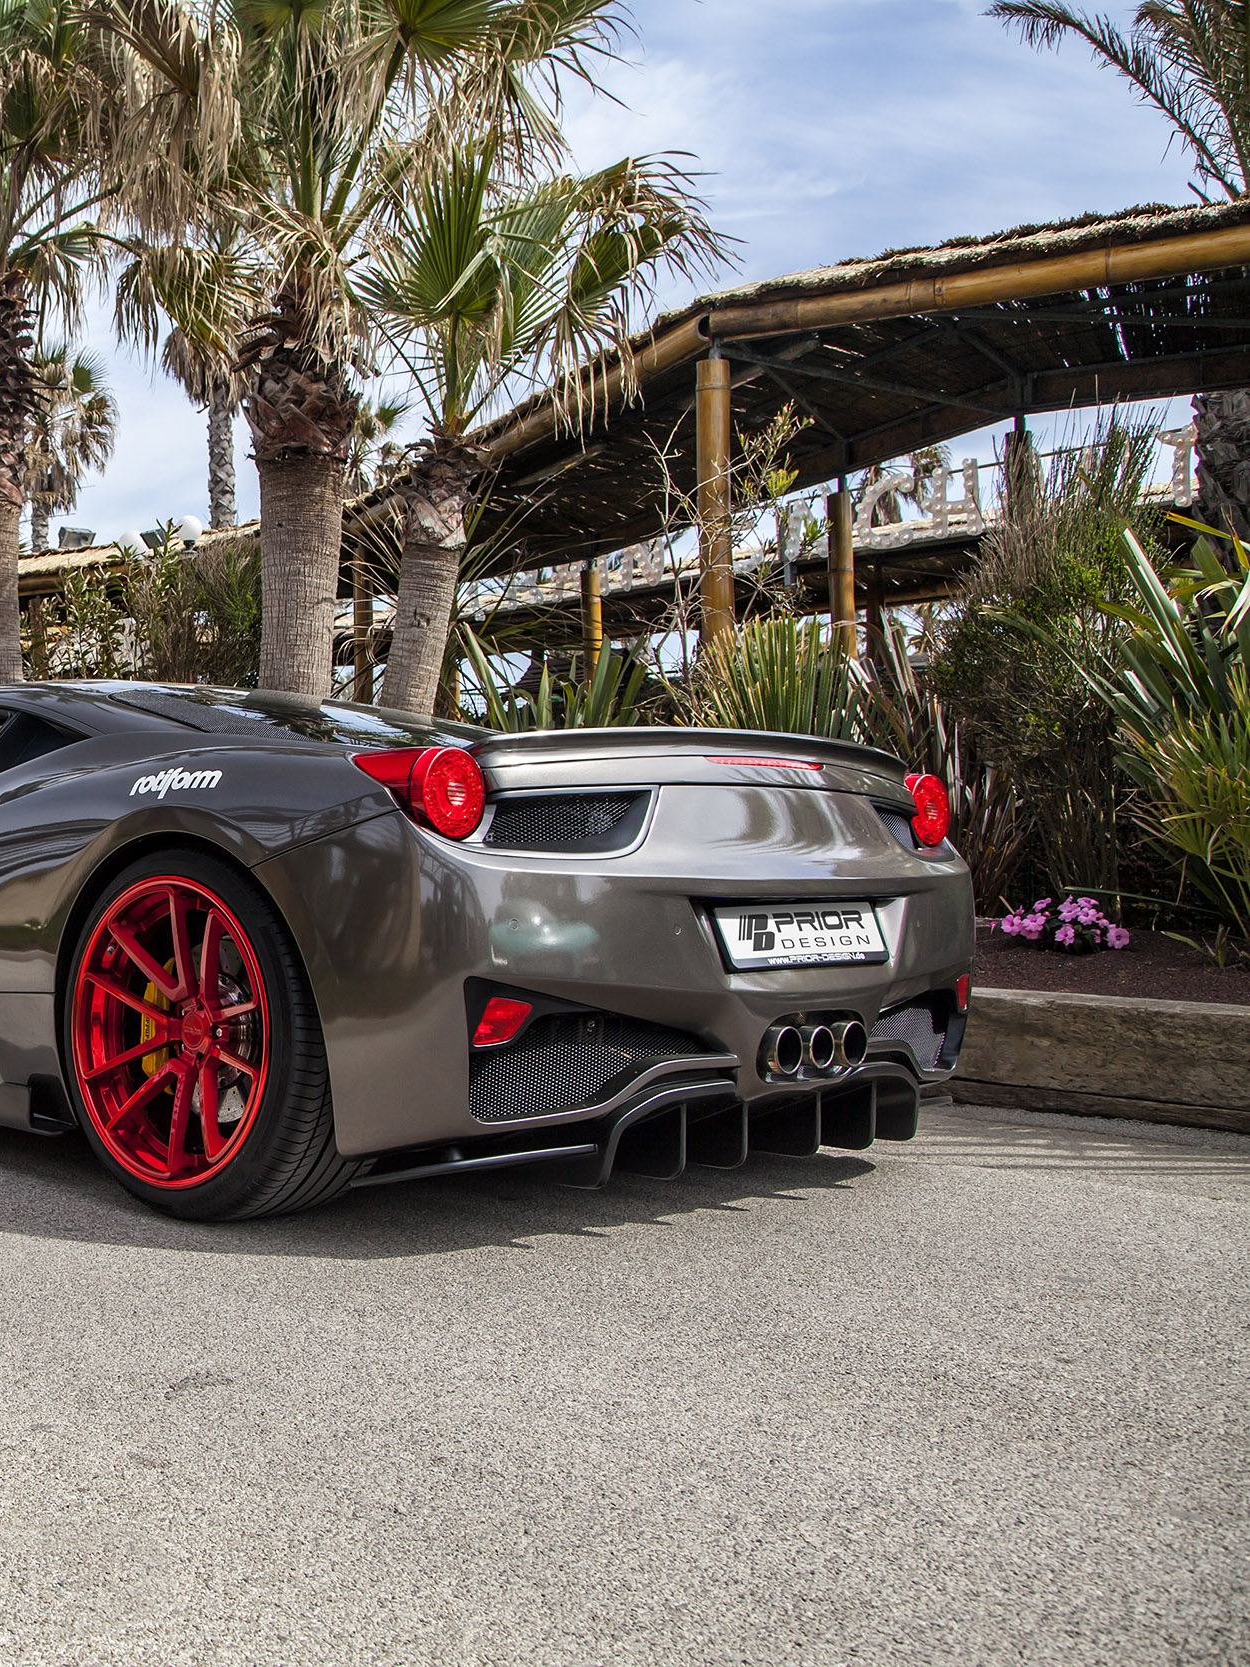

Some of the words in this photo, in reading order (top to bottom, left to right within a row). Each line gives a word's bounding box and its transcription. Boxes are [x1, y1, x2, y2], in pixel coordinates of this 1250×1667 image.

[129, 767, 223, 799] rotiform
[772, 910, 865, 933] PRIOR
[781, 934, 871, 949] DESIGN
